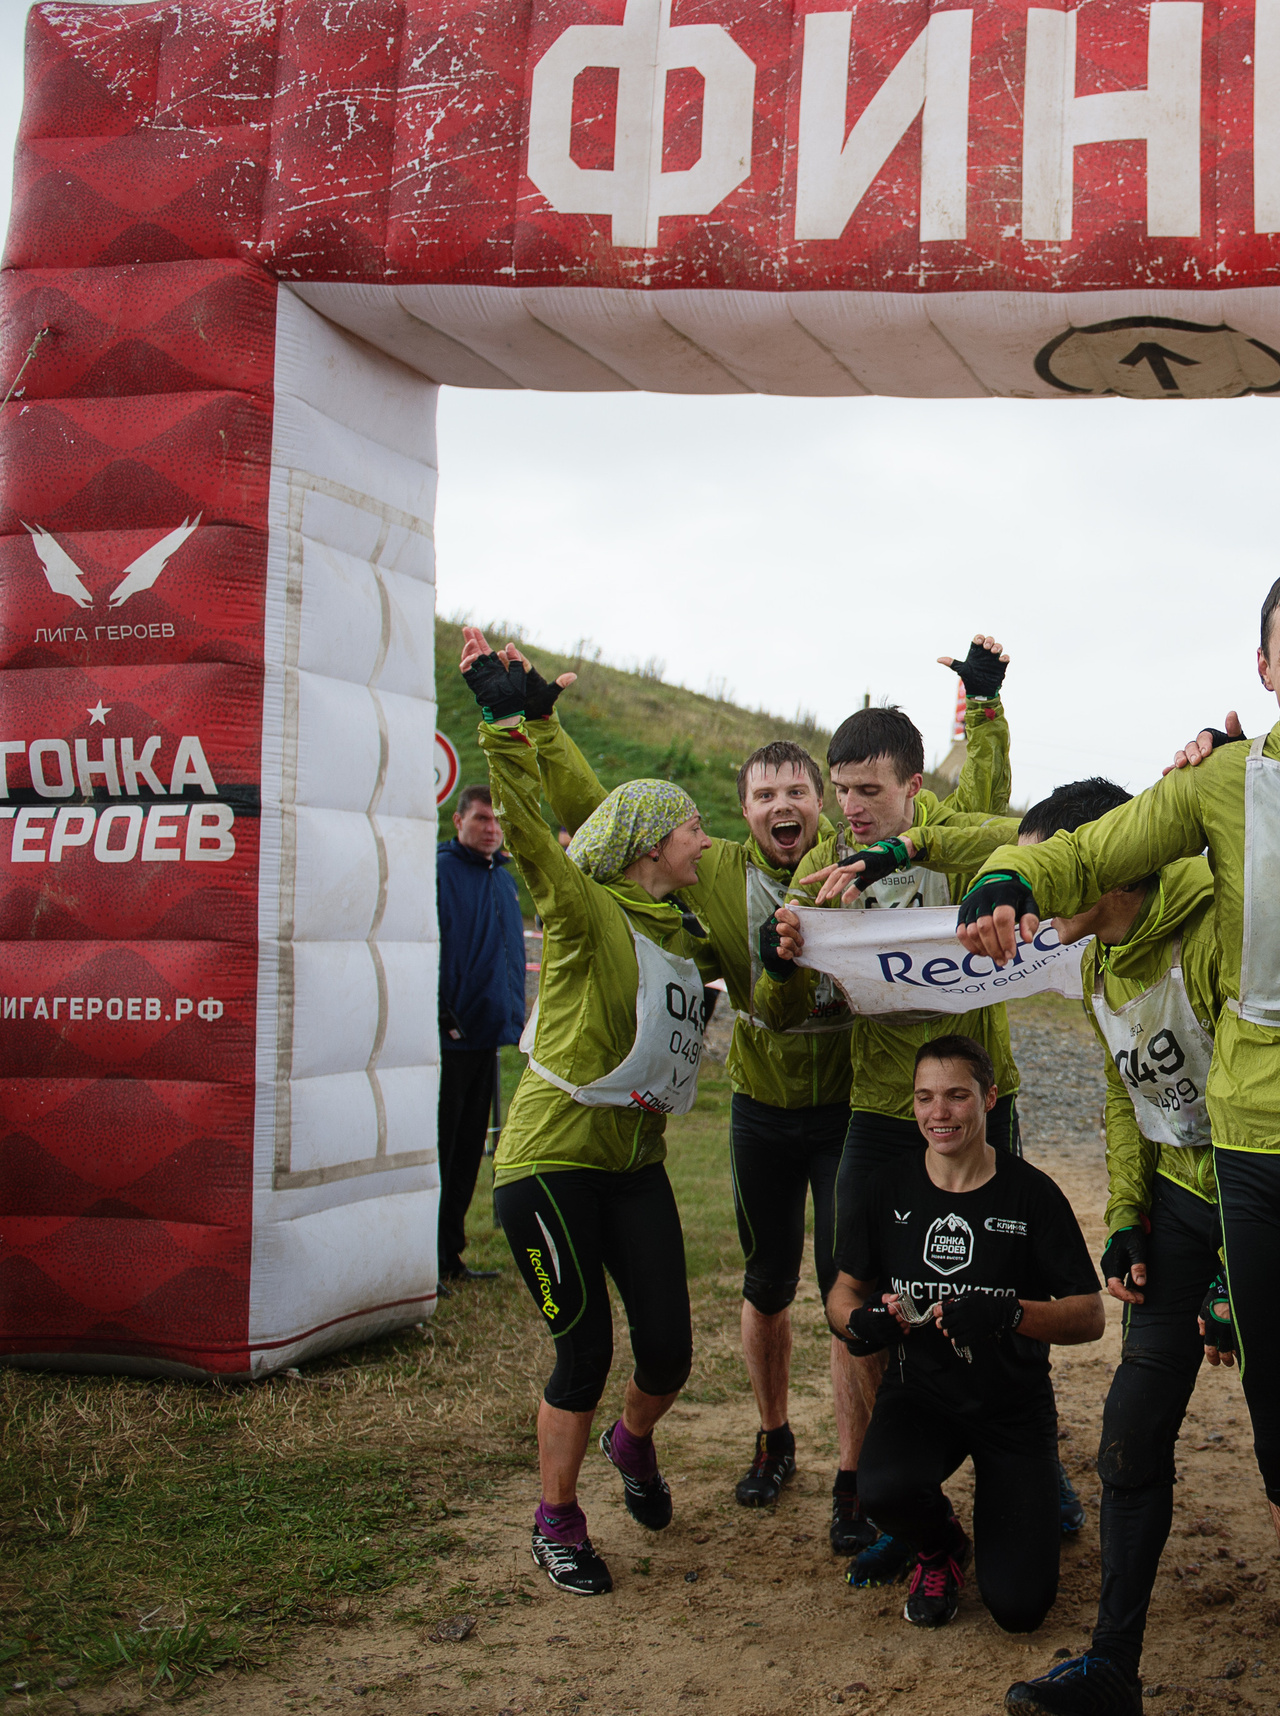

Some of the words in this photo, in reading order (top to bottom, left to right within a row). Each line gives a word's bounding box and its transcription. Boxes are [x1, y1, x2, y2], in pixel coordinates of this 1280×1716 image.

[33, 626, 89, 643] ЛИГА
[94, 622, 176, 642] ГЕРОЕВ
[0, 997, 224, 1022] ИГАГЕРОЕВ.РФ
[930, 1244, 966, 1255] ГЕРОЕВ
[934, 1235, 965, 1246] ГОНКА
[526, 1247, 553, 1302] RedFox
